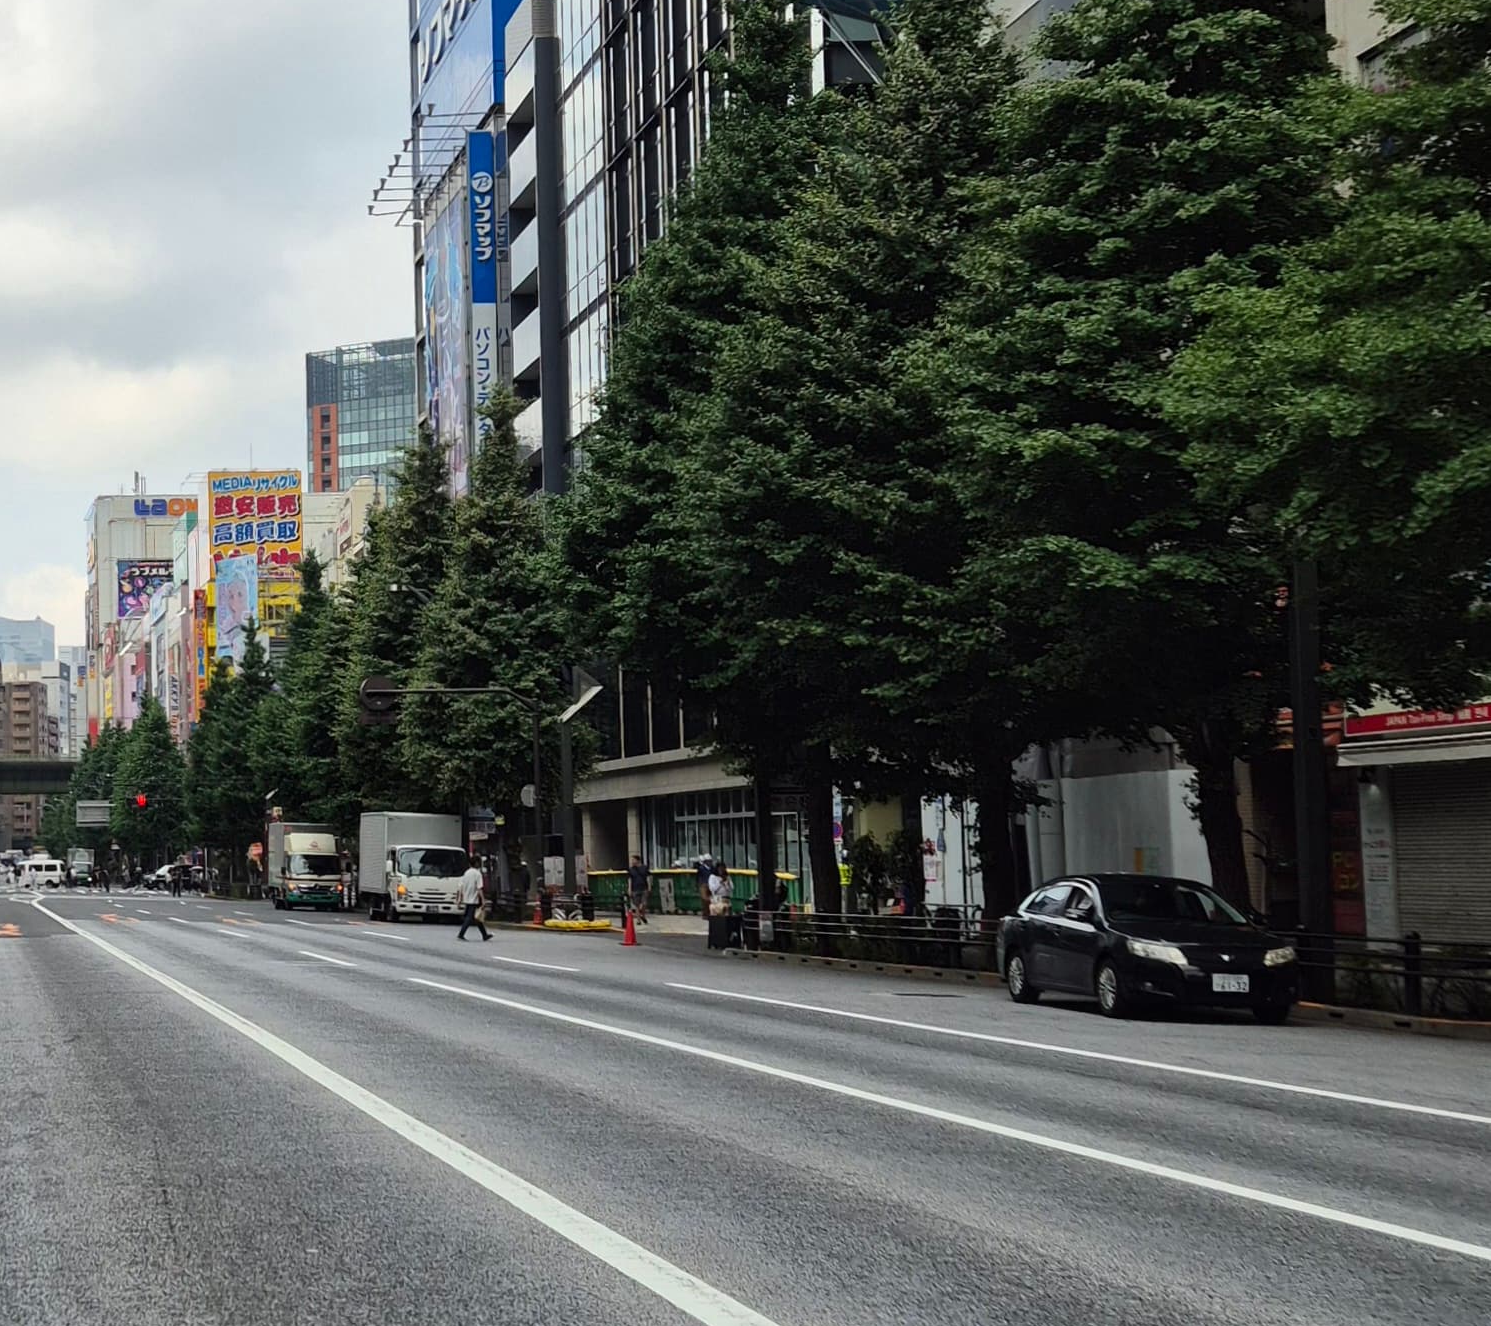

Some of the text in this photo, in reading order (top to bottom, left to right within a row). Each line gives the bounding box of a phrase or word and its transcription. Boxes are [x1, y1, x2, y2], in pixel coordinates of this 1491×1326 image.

[473, 195, 494, 261] ソフマップ
[213, 521, 297, 544] 高額買取
